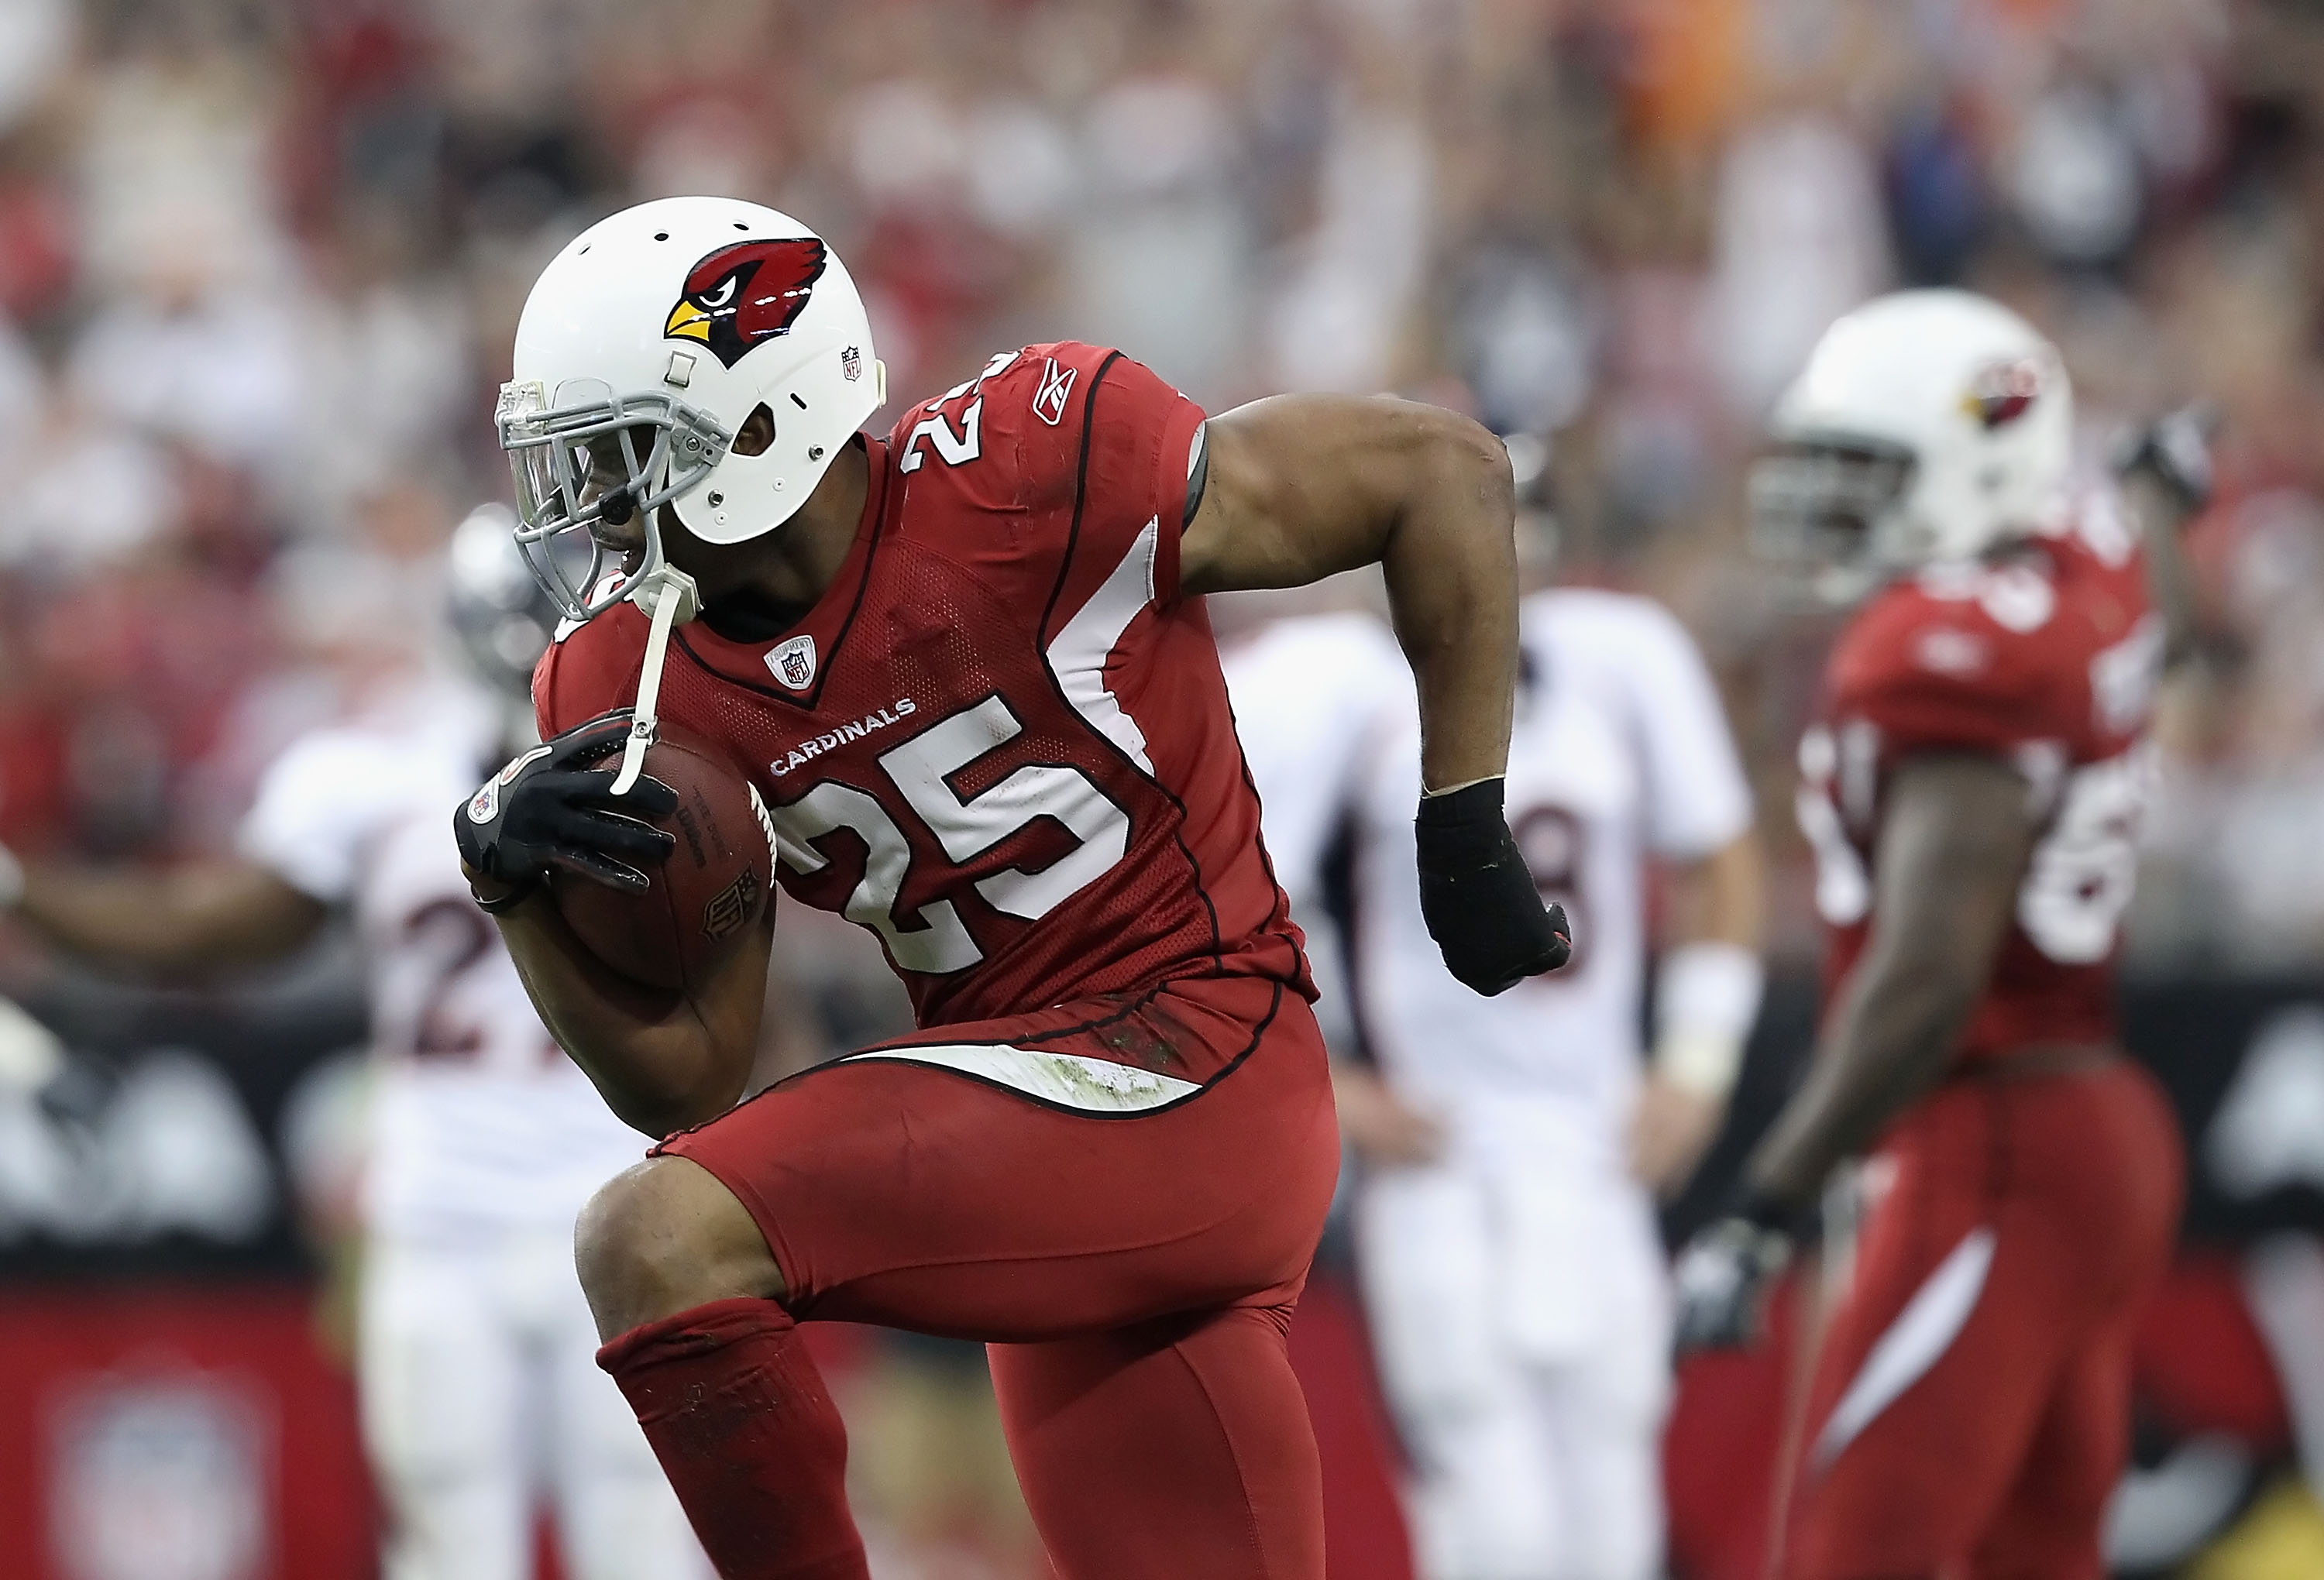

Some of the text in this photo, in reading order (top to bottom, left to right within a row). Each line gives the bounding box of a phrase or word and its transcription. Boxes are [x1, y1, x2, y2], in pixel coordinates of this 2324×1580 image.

[844, 359, 860, 378] NFL
[787, 664, 808, 682] NFL
[769, 697, 916, 778] CARDINALS
[771, 695, 1129, 974] 25
